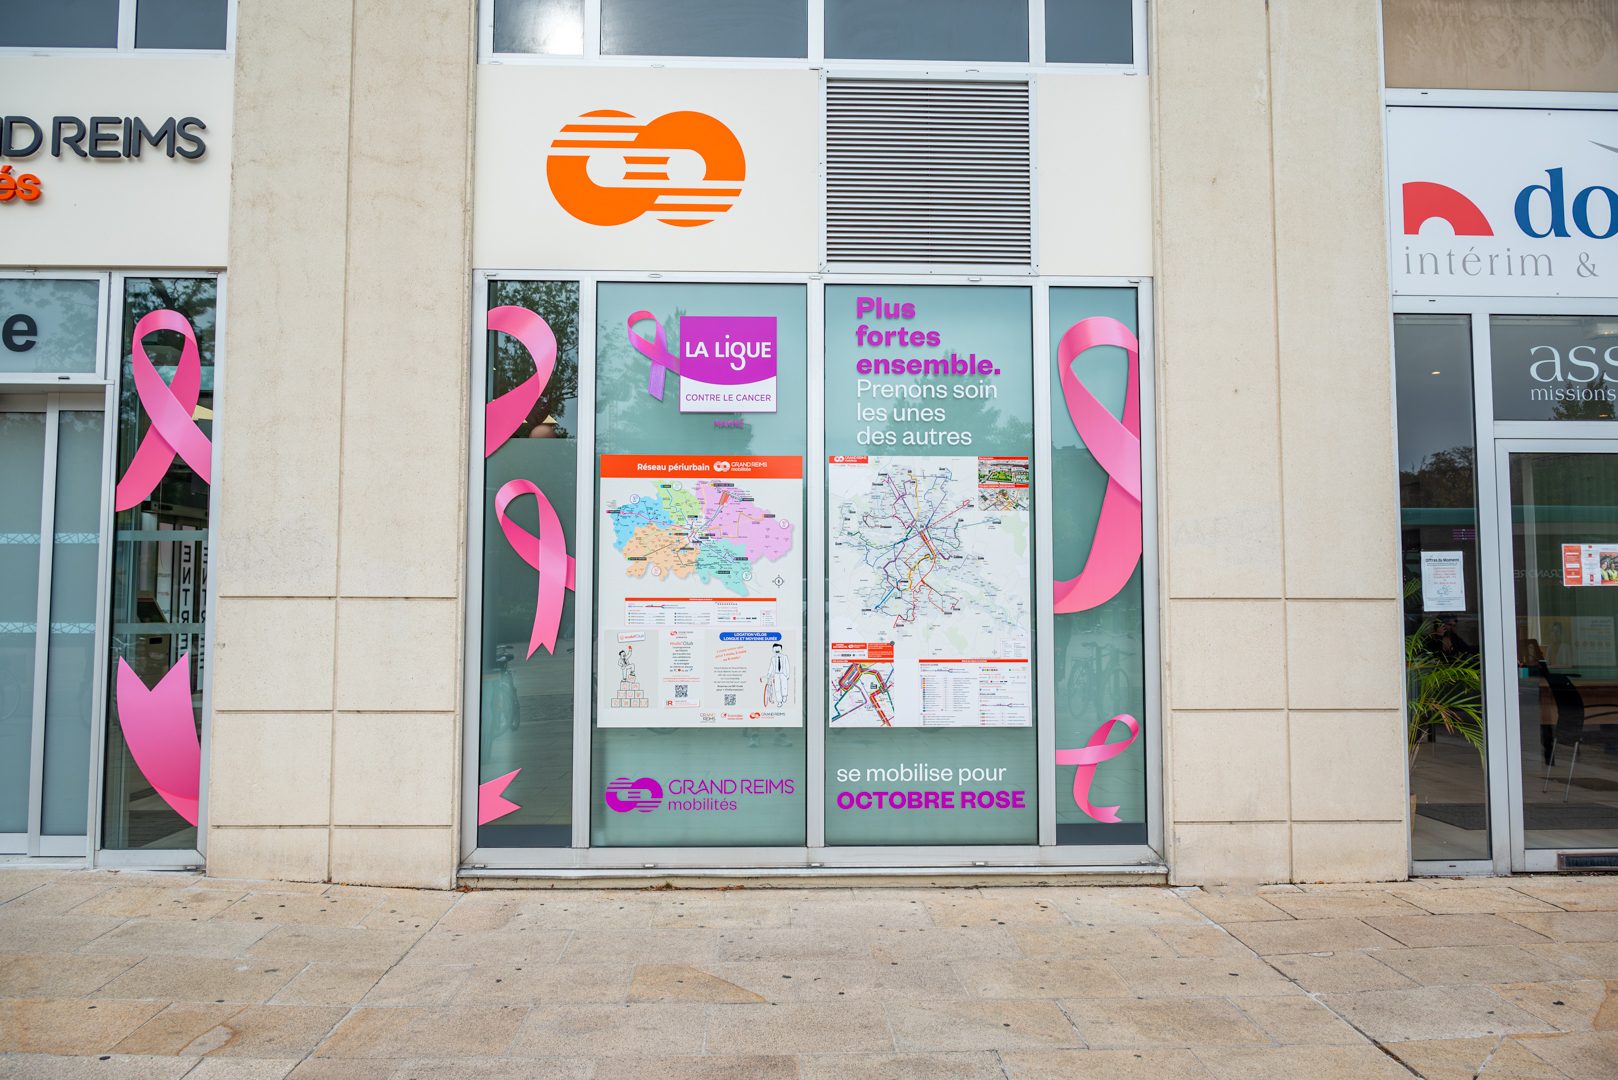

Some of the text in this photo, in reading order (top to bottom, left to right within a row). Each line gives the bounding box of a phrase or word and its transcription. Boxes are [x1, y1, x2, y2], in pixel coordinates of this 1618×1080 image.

[0, 116, 207, 158] D REIMS
[1514, 167, 1618, 239] do
[1404, 246, 1599, 278] intérim &
[856, 297, 916, 319] Plus
[2, 313, 38, 352] e
[855, 324, 941, 347] fortes
[685, 341, 709, 358] LA
[856, 354, 1001, 375] ensemble.
[685, 393, 772, 402] CONTRE LE CANCER
[857, 379, 997, 399] Prenons soin
[1530, 386, 1617, 401] missions
[857, 402, 946, 422] les unes
[857, 427, 973, 446] des autres
[637, 463, 710, 473] Réseau périurbain
[836, 763, 1007, 786] se mobilise pour
[668, 779, 795, 795] GRAND REIMS
[668, 797, 737, 811] mobilités
[836, 790, 1026, 810] OCTOBRE ROSE
